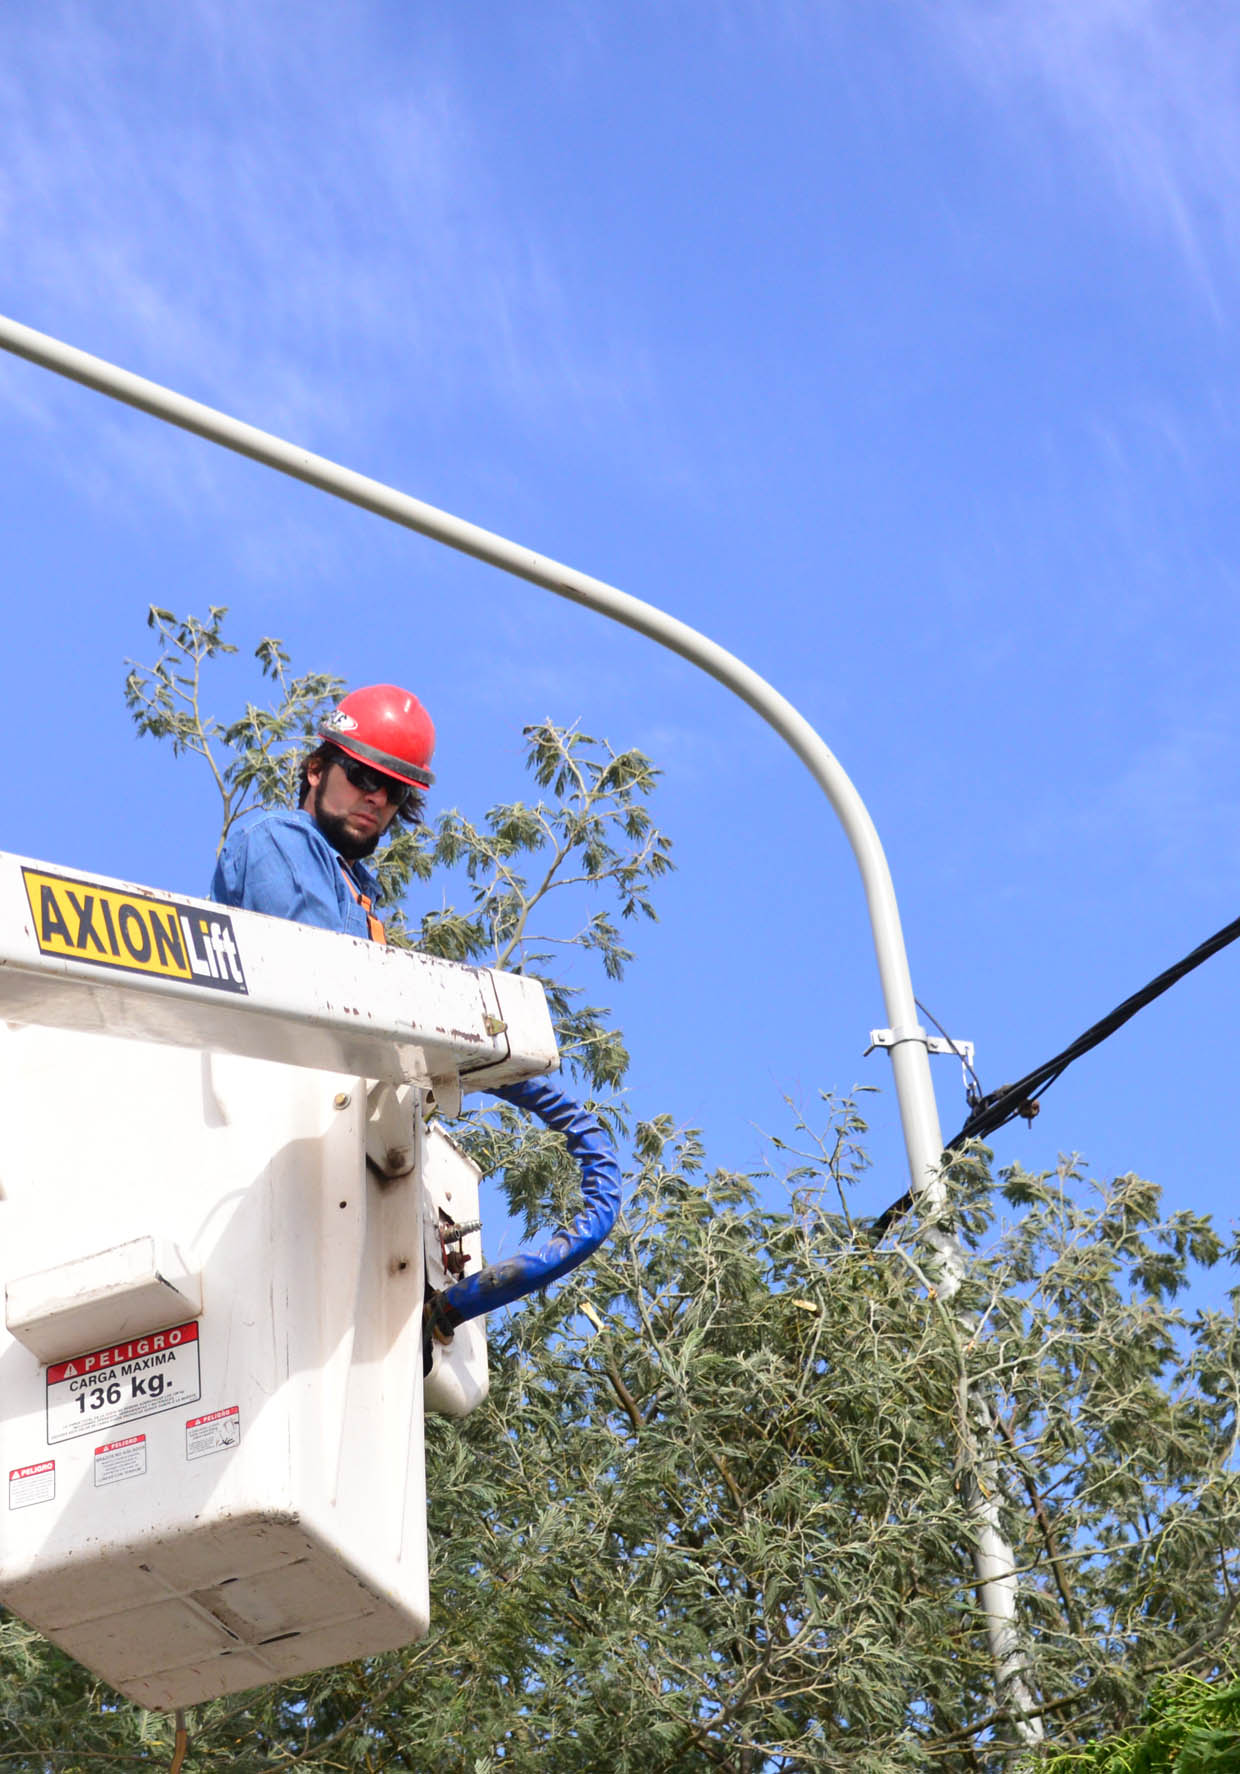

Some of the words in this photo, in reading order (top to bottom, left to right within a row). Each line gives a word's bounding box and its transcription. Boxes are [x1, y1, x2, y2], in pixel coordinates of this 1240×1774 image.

[40, 884, 187, 970] AXION
[180, 915, 244, 984] Lift
[85, 1331, 182, 1371] PELIGRO
[69, 1370, 117, 1392] CARGA
[121, 1351, 176, 1377] MAXIMA
[75, 1383, 121, 1413] 136
[131, 1373, 173, 1398] kg.
[21, 1462, 53, 1477] PELIGRO
